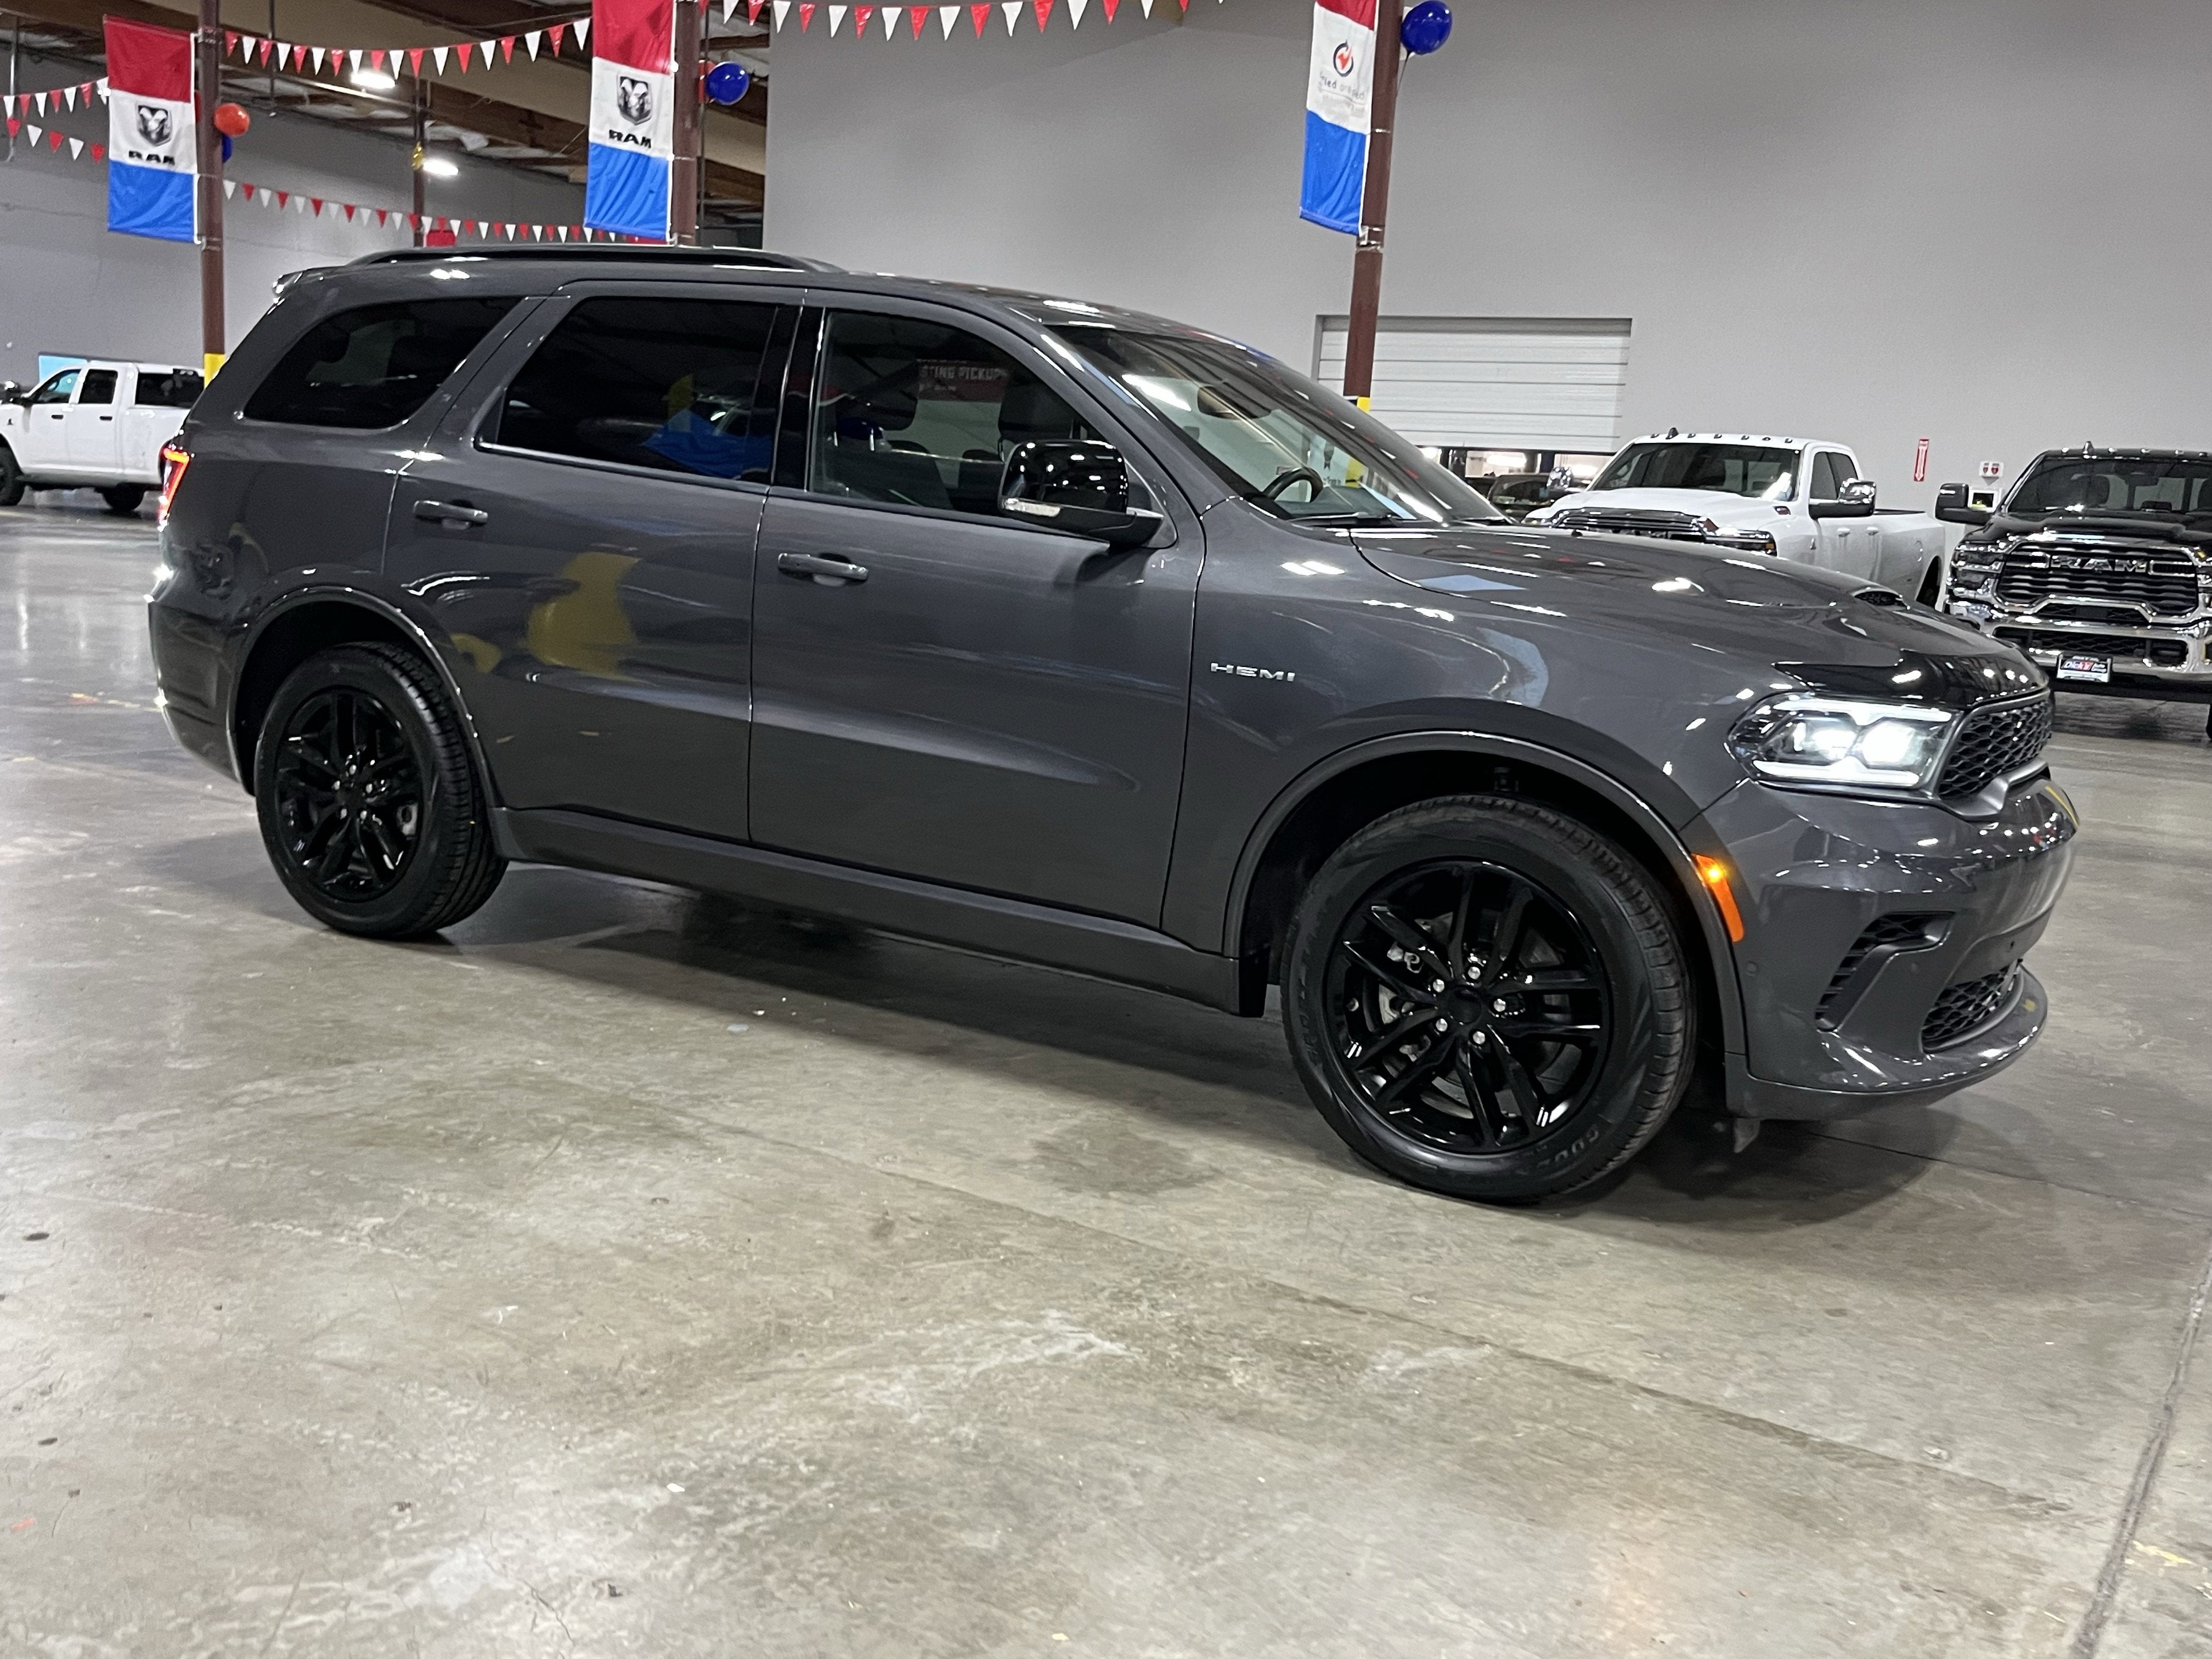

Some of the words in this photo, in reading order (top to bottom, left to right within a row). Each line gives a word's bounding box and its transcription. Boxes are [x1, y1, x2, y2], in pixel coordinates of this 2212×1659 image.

[608, 129, 652, 149] RAM
[128, 150, 175, 166] RAM
[2051, 555, 2147, 573] RAM
[1210, 662, 1295, 682] HEMI
